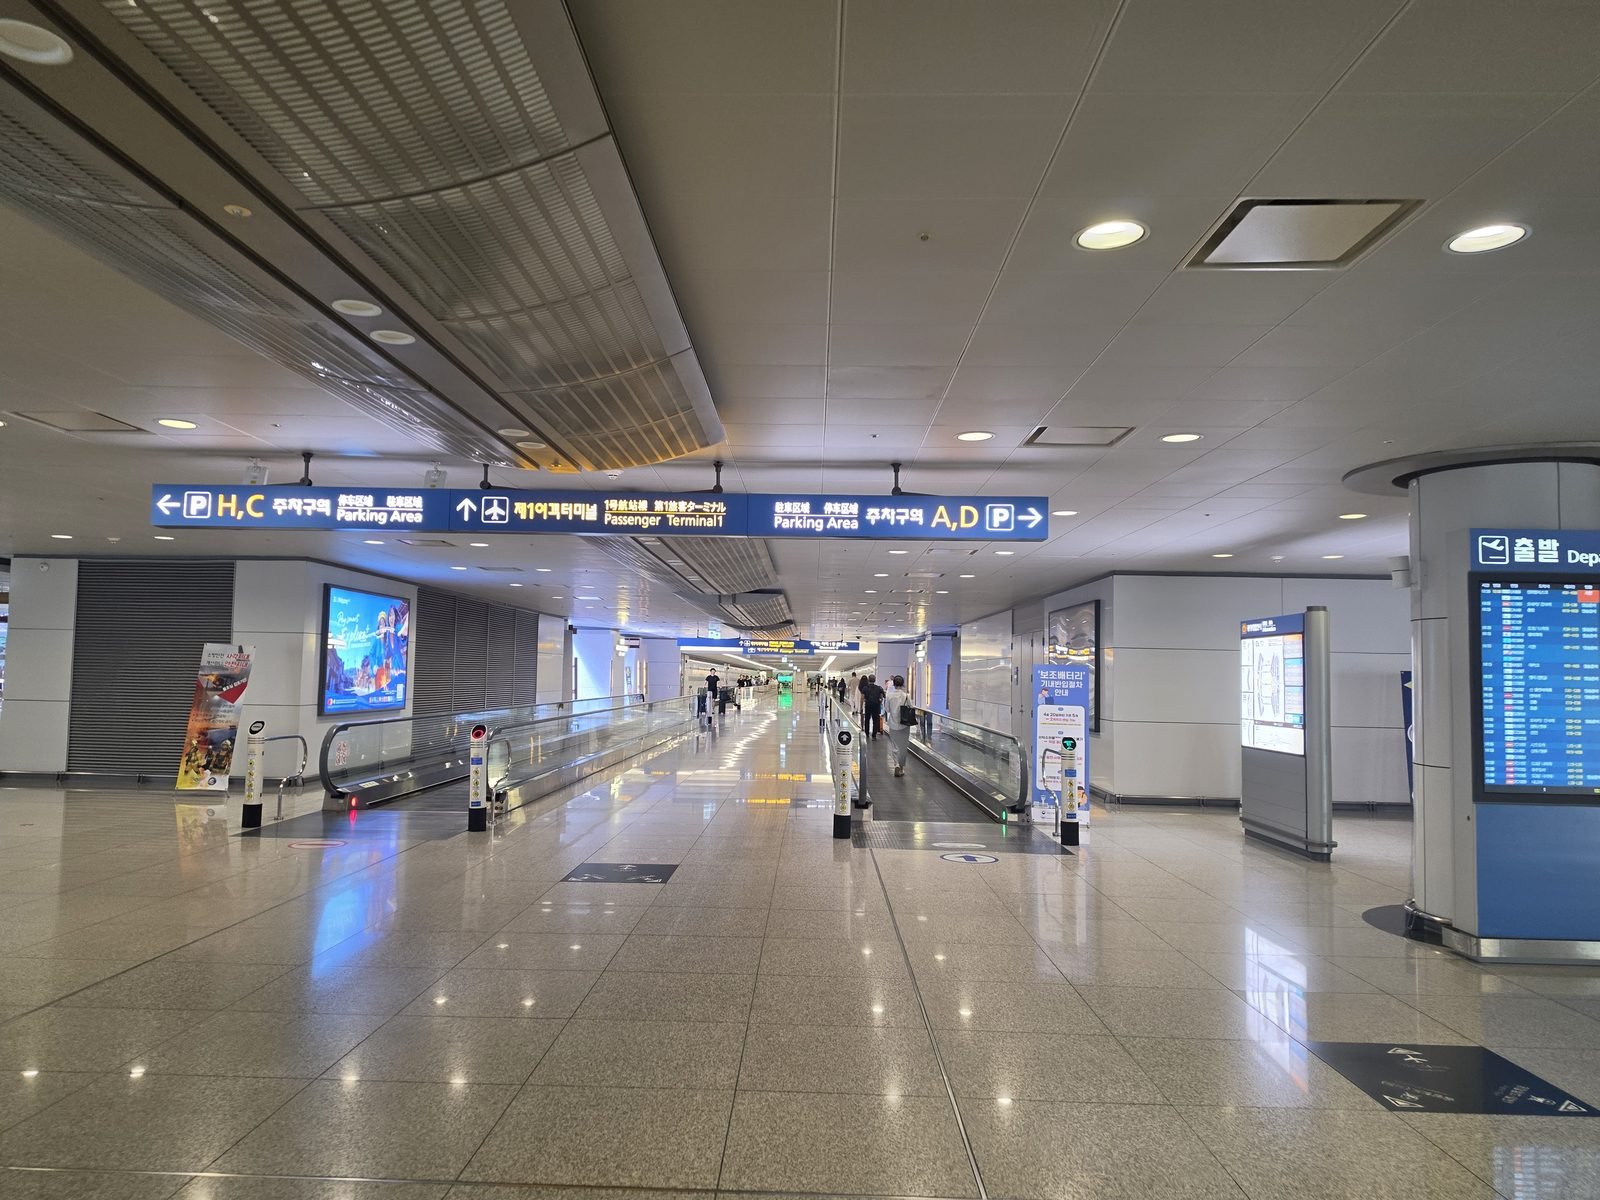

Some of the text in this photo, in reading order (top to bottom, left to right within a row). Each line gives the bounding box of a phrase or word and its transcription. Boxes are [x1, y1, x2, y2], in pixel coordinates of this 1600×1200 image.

[217, 494, 265, 520] H,C
[272, 498, 331, 517] 주차구역
[336, 508, 423, 524] Parking Area
[604, 513, 661, 528] Passenger
[774, 515, 859, 531] Parking Area
[865, 507, 923, 525] 주차구역
[931, 505, 979, 531] A,D
[1513, 537, 1560, 563] 출발
[1040, 680, 1083, 689] 기내반입절차
[1054, 689, 1069, 697] 안내
